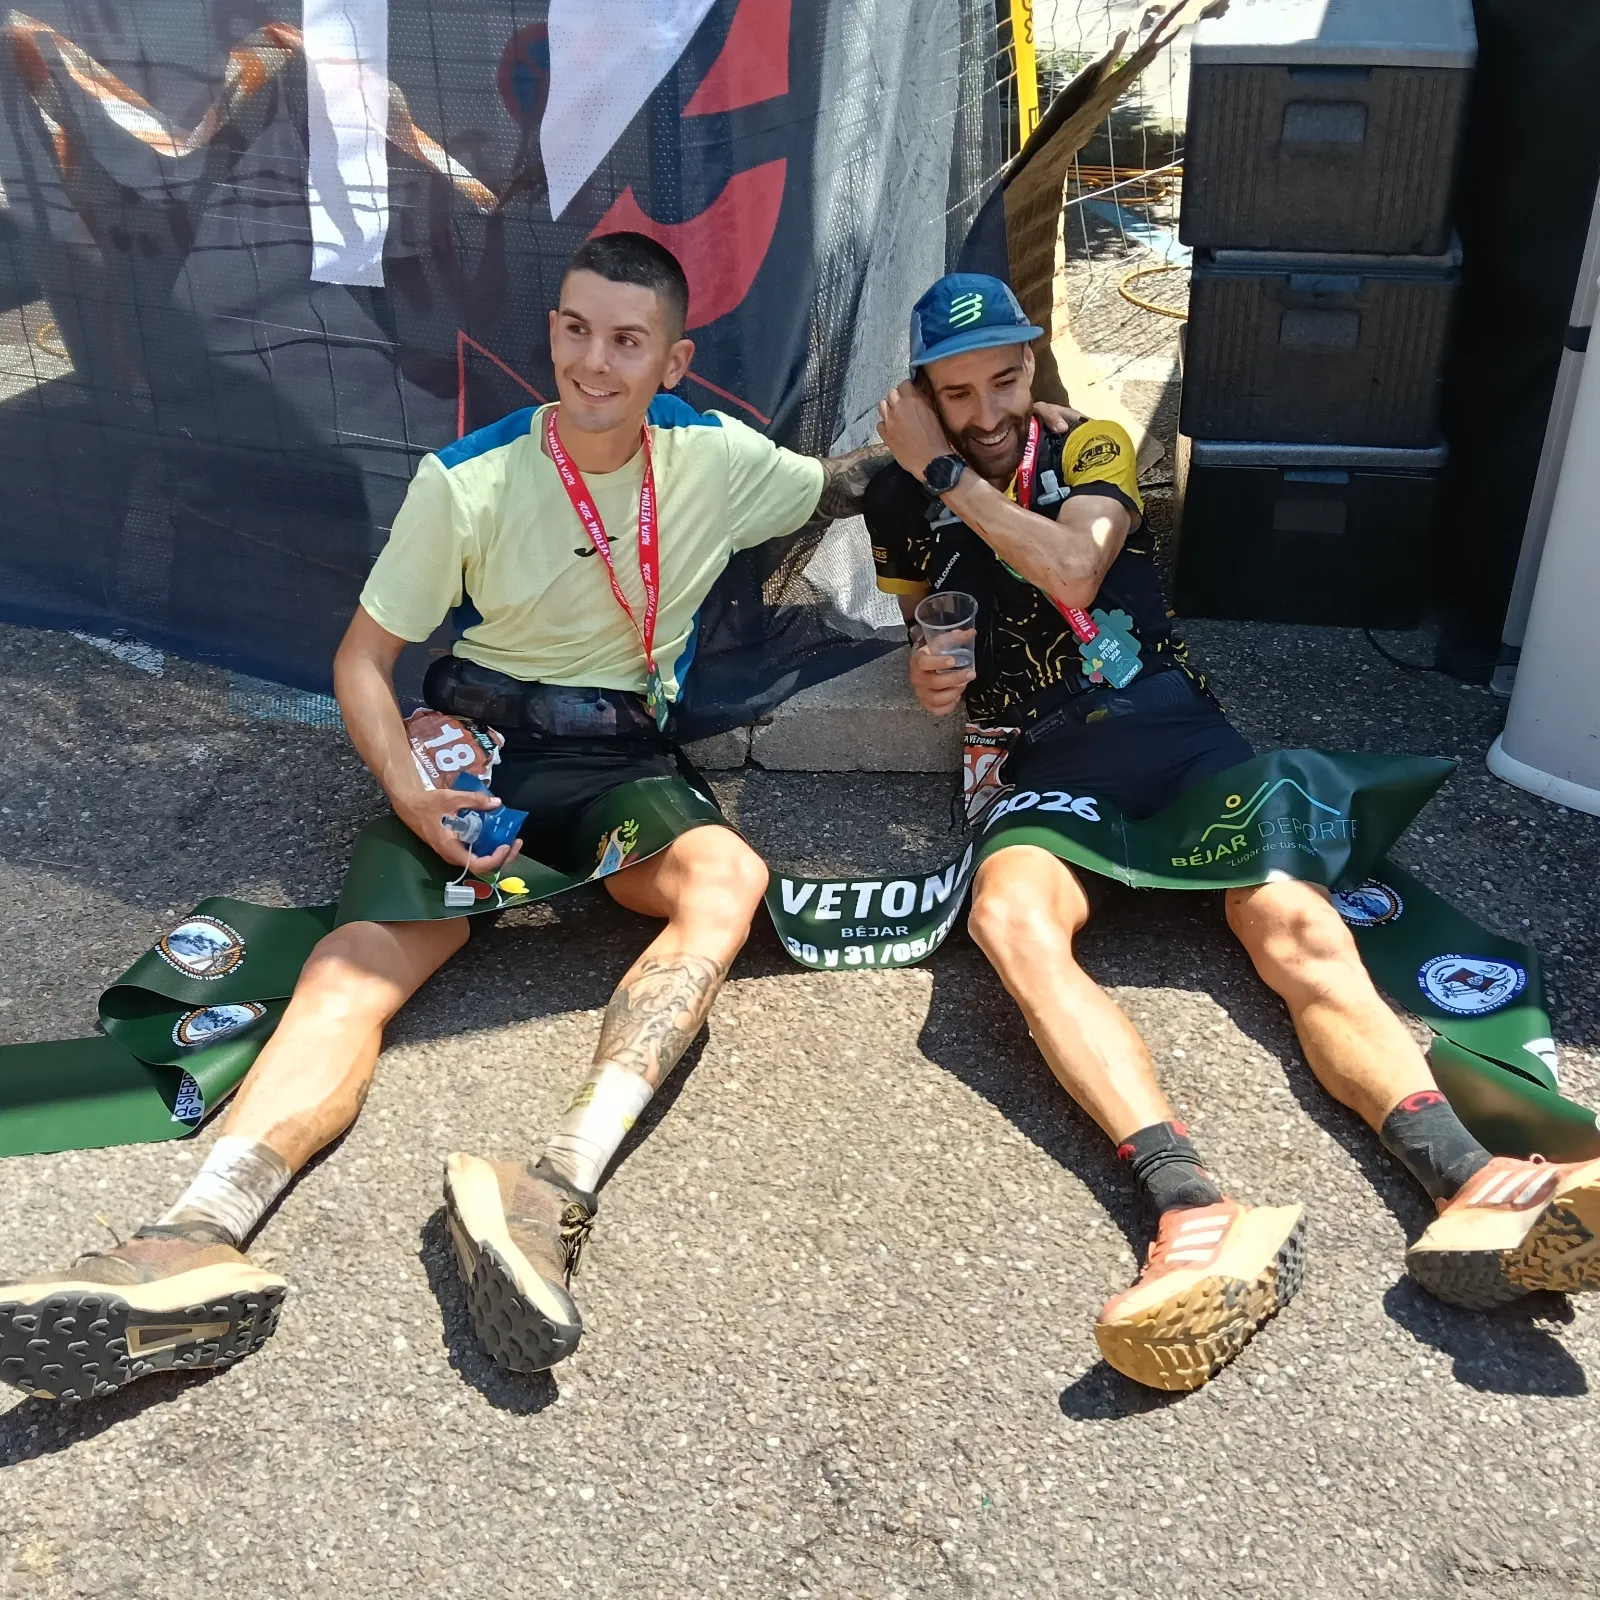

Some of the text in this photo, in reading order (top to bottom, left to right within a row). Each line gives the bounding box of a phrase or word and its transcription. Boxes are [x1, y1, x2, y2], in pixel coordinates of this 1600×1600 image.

[548, 429, 564, 465] VETONA
[560, 465, 575, 487] RUTA
[577, 500, 594, 521] 2026
[640, 487, 651, 526] VETONA
[588, 521, 611, 556] VETONA
[641, 525, 651, 546] RUTA
[642, 562, 652, 582] 2026
[934, 551, 960, 590] SALOMON
[1069, 608, 1092, 634] ETONA
[1099, 639, 1121, 661] VETONA
[423, 723, 476, 772] 18
[969, 734, 996, 746] VETONA
[409, 737, 440, 779] ALEJANDRO
[982, 791, 1101, 836] 2026
[1171, 833, 1248, 867] BÉJAR
[1262, 842, 1277, 852] de
[1279, 840, 1297, 850] tus
[781, 842, 974, 921] VETONA
[841, 925, 909, 938] BÉJAR
[787, 936, 818, 964] 30
[823, 949, 839, 968] y
[1420, 953, 1462, 974] MONTAÑA
[174, 1106, 202, 1118] de
